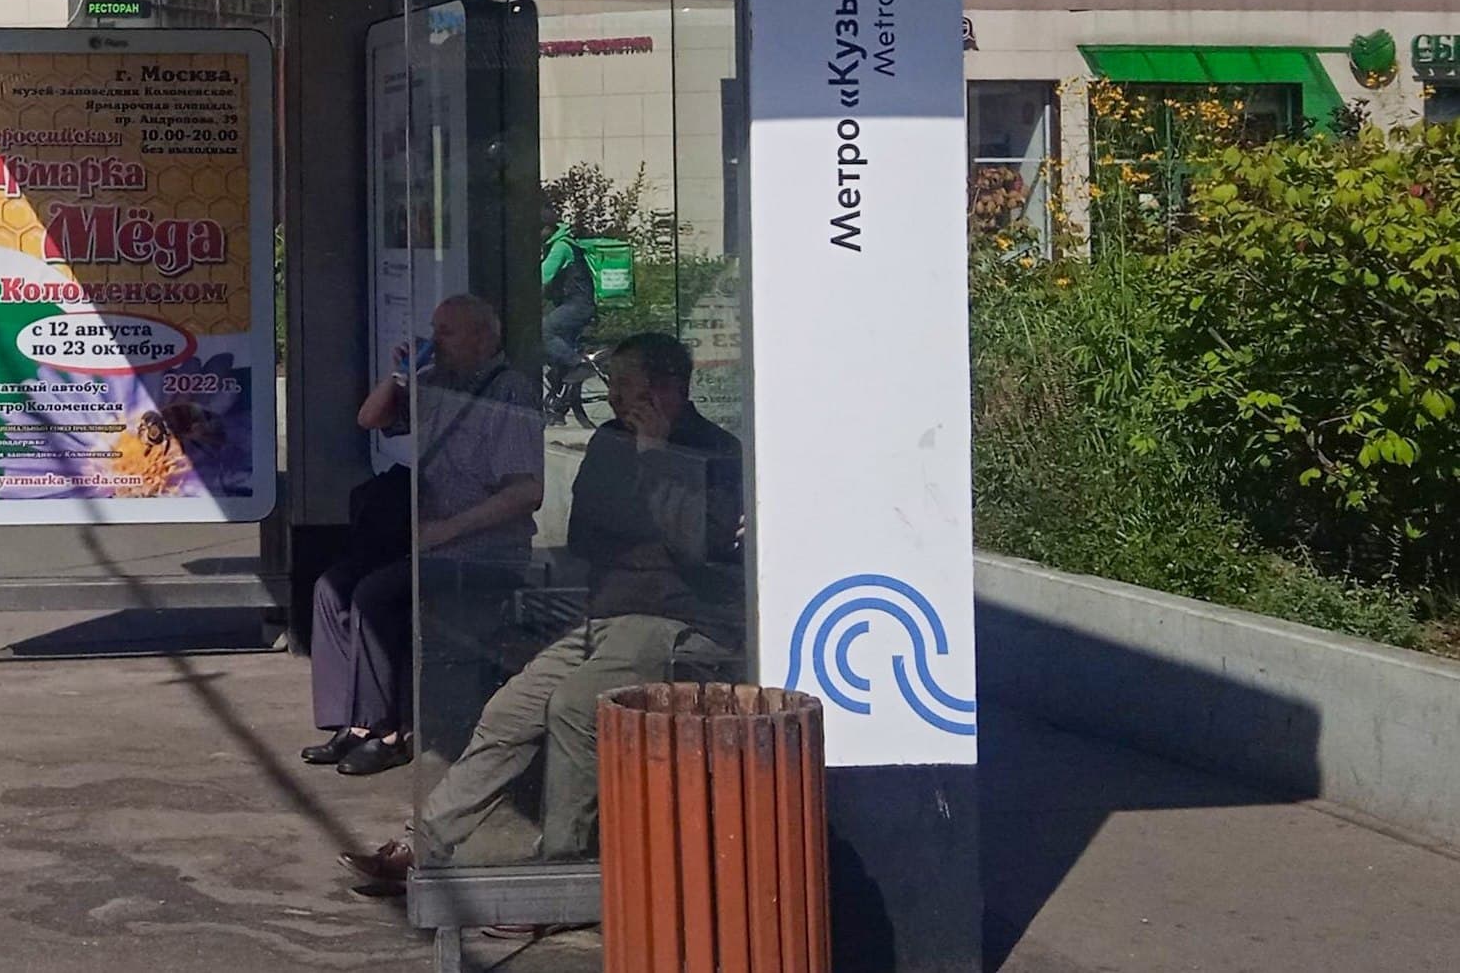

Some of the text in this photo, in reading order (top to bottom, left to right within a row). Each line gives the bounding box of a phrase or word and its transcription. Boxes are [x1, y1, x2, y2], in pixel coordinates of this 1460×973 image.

[88, 2, 139, 14] РЕСТОРАН
[115, 65, 239, 84] г. Москва,
[224, 113, 238, 125] 39
[142, 128, 238, 142] 10.00-20.00
[141, 144, 238, 155] без выходных
[830, 120, 868, 252] Метро
[44, 202, 226, 275] Мёда
[0, 277, 228, 305] Коломенском
[31, 321, 153, 340] с 12 августа
[32, 341, 176, 359] по 23 октября
[51, 381, 108, 396] автобус
[164, 375, 219, 393] 2022
[26, 400, 124, 413] Коломенская
